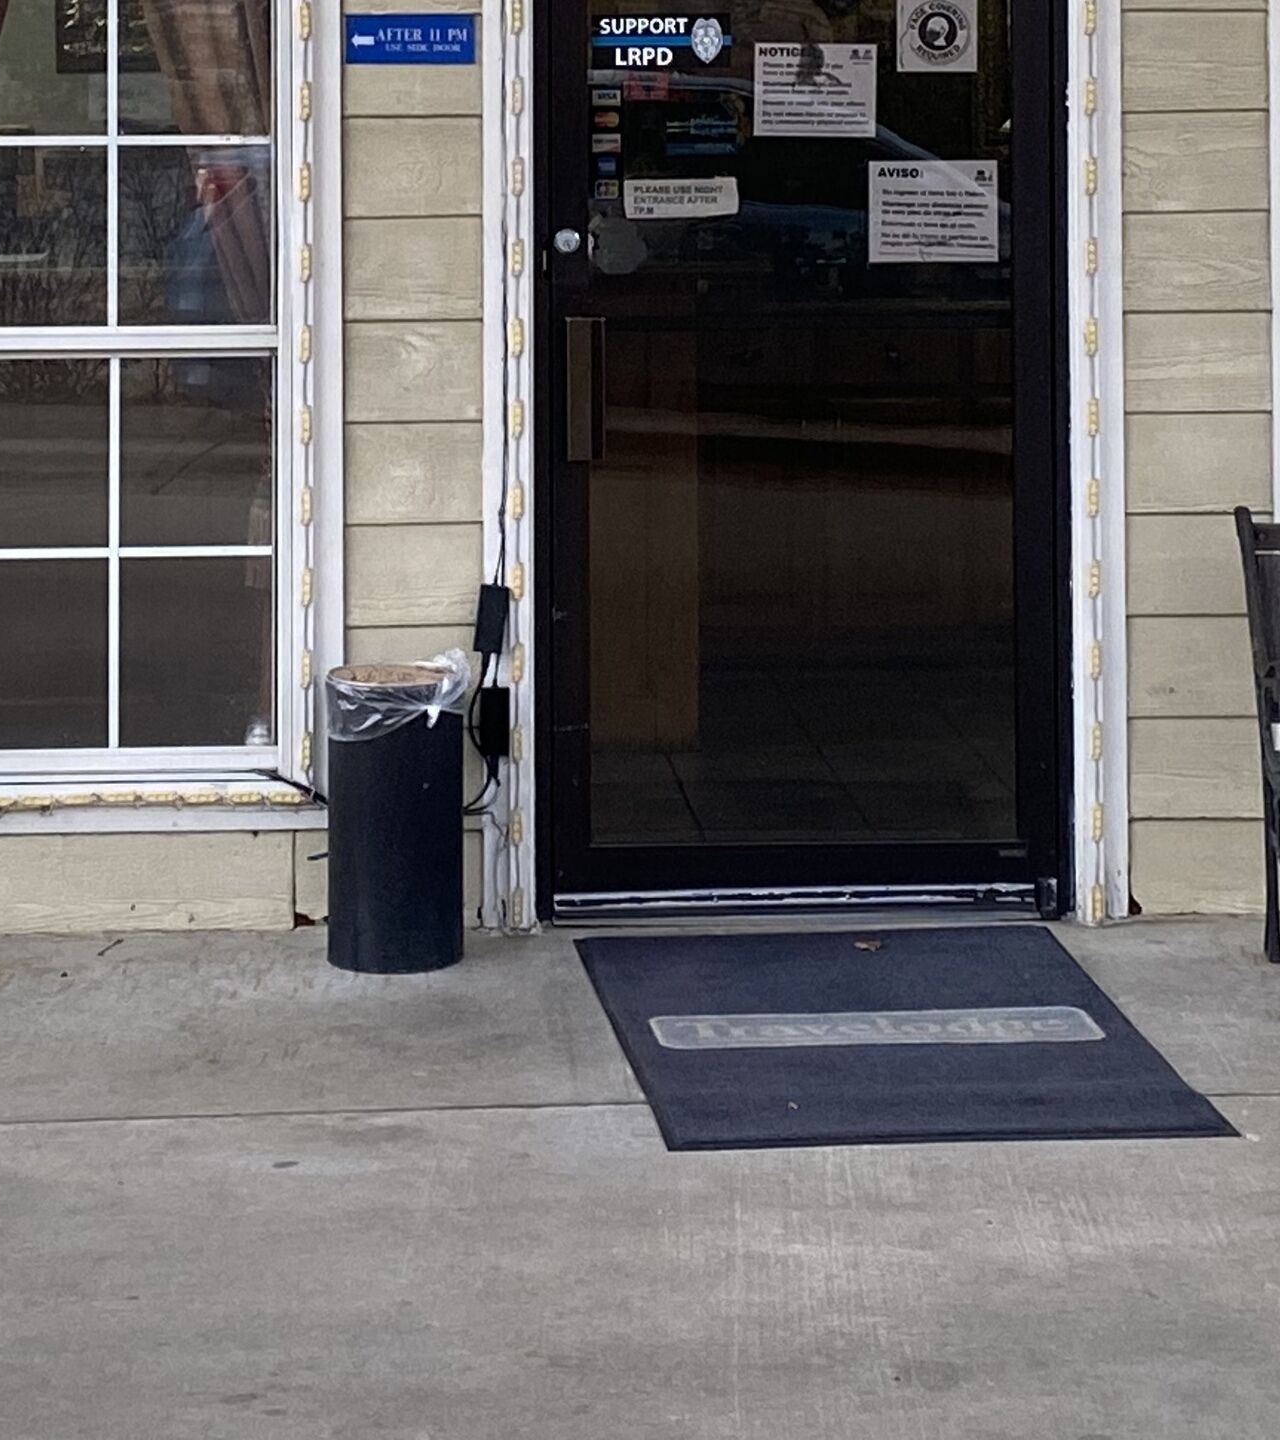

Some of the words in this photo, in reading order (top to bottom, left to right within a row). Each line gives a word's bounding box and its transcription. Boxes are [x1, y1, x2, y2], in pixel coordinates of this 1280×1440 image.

[599, 18, 688, 34] SUPPORT
[376, 28, 422, 42] AFTER
[429, 29, 441, 42] 11
[447, 29, 468, 42] PM
[614, 47, 673, 66] LRPD
[633, 185, 670, 194] PLEASE
[673, 185, 692, 194] USE
[694, 185, 724, 194] NIGHT
[633, 196, 685, 205] ENTRANCE
[687, 196, 718, 204] AFTER
[675, 1017, 1069, 1040] Travelodge
